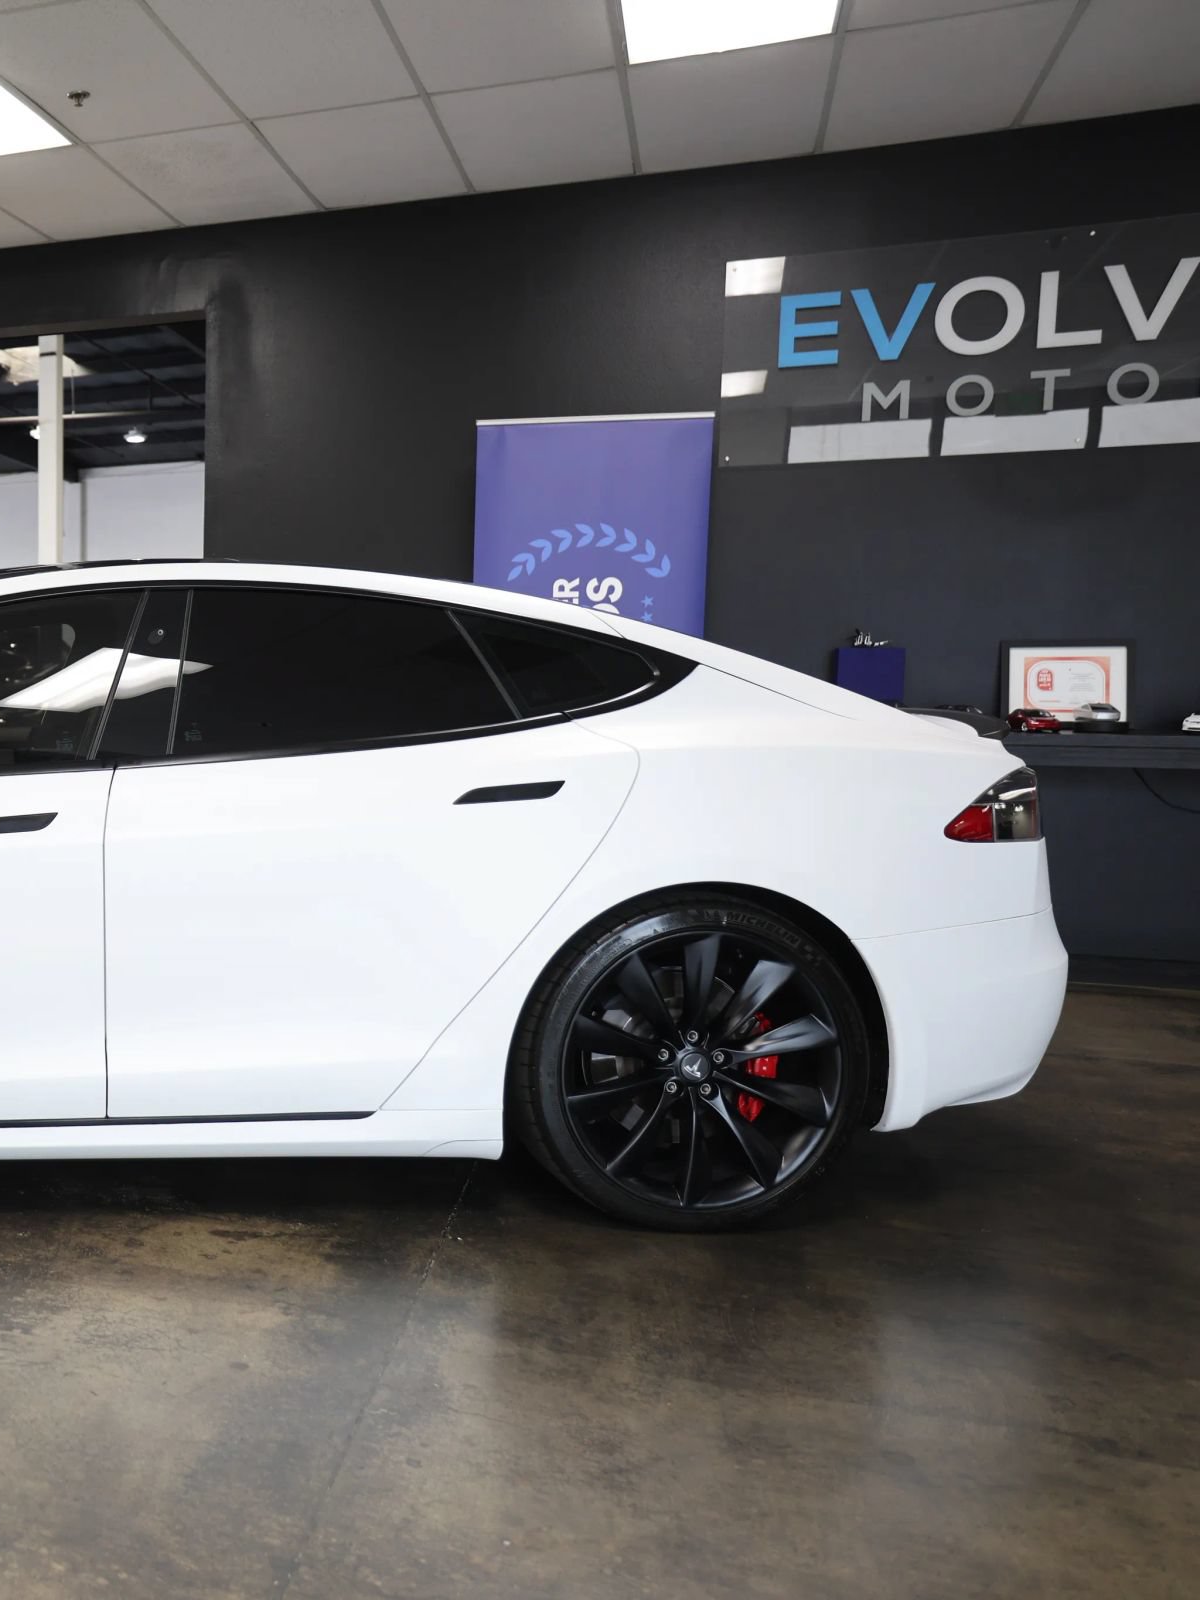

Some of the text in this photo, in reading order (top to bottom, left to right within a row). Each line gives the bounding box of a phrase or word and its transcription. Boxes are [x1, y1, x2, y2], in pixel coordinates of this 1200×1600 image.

[777, 256, 1200, 368] EVOLV
[861, 362, 1160, 422] MOTO
[727, 910, 801, 949] MICHELIN
